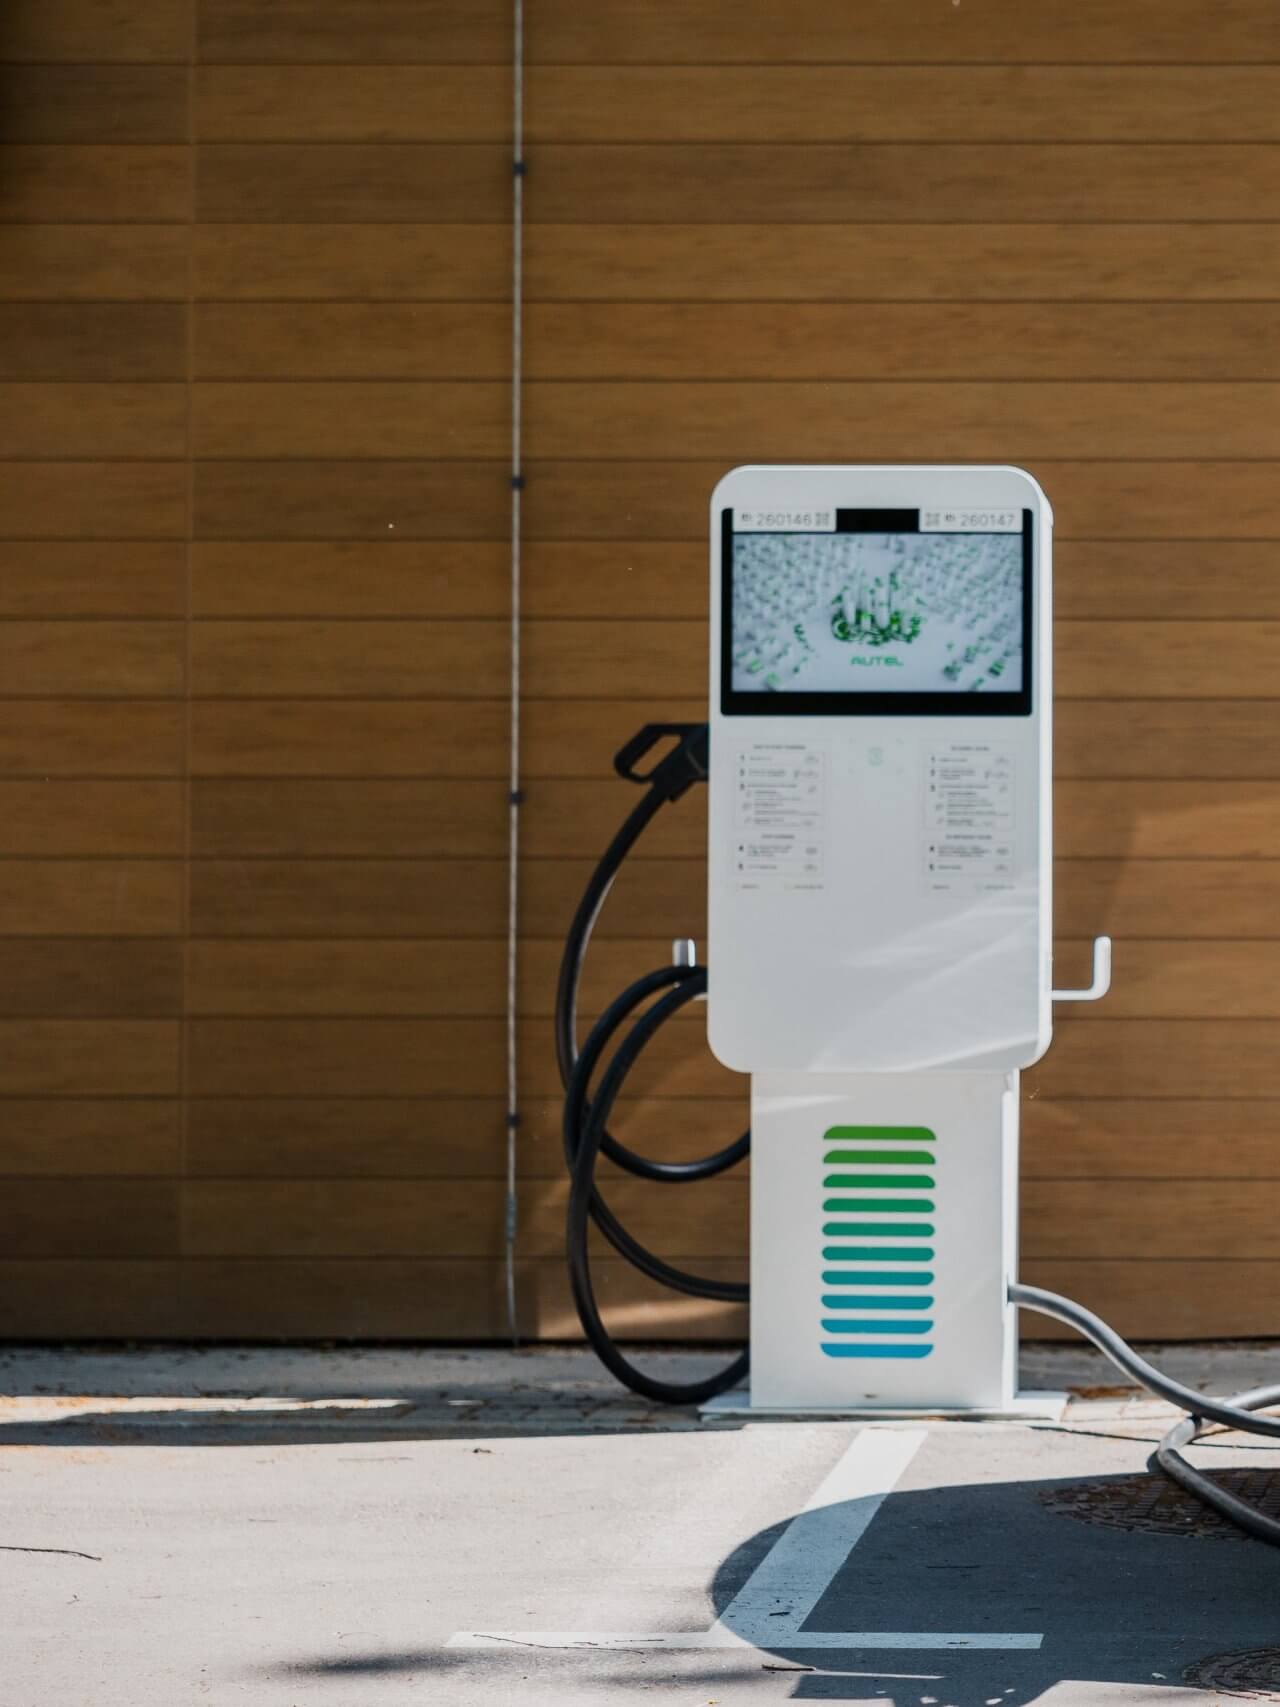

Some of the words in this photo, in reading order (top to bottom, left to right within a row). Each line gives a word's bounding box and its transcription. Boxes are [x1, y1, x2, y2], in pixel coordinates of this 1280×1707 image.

[756, 512, 813, 527] 260146
[960, 512, 1016, 527] 260147
[851, 656, 905, 667] AUTEL
